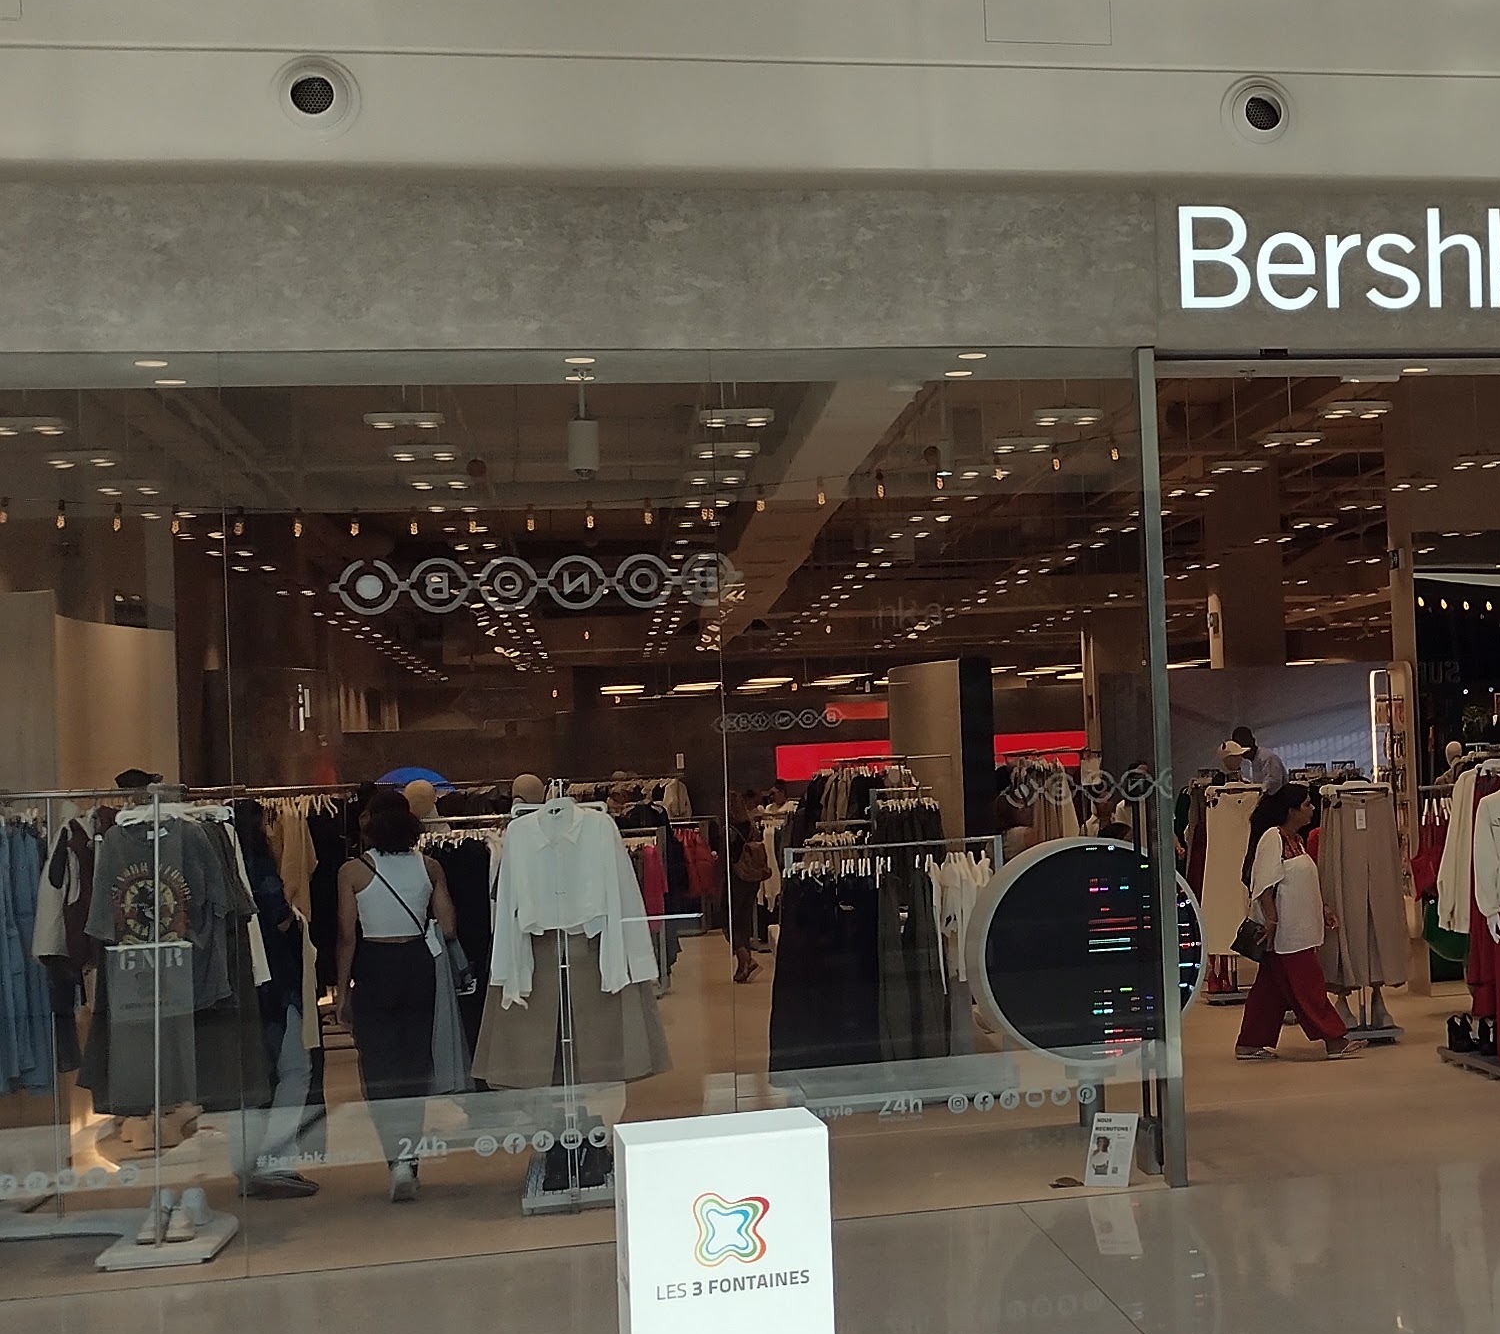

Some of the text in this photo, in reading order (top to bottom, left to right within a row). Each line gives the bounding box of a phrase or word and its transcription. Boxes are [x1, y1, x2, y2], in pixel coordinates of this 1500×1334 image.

[398, 1136, 448, 1158] 24h
[656, 1269, 811, 1301] LES 3 FONTAINES
